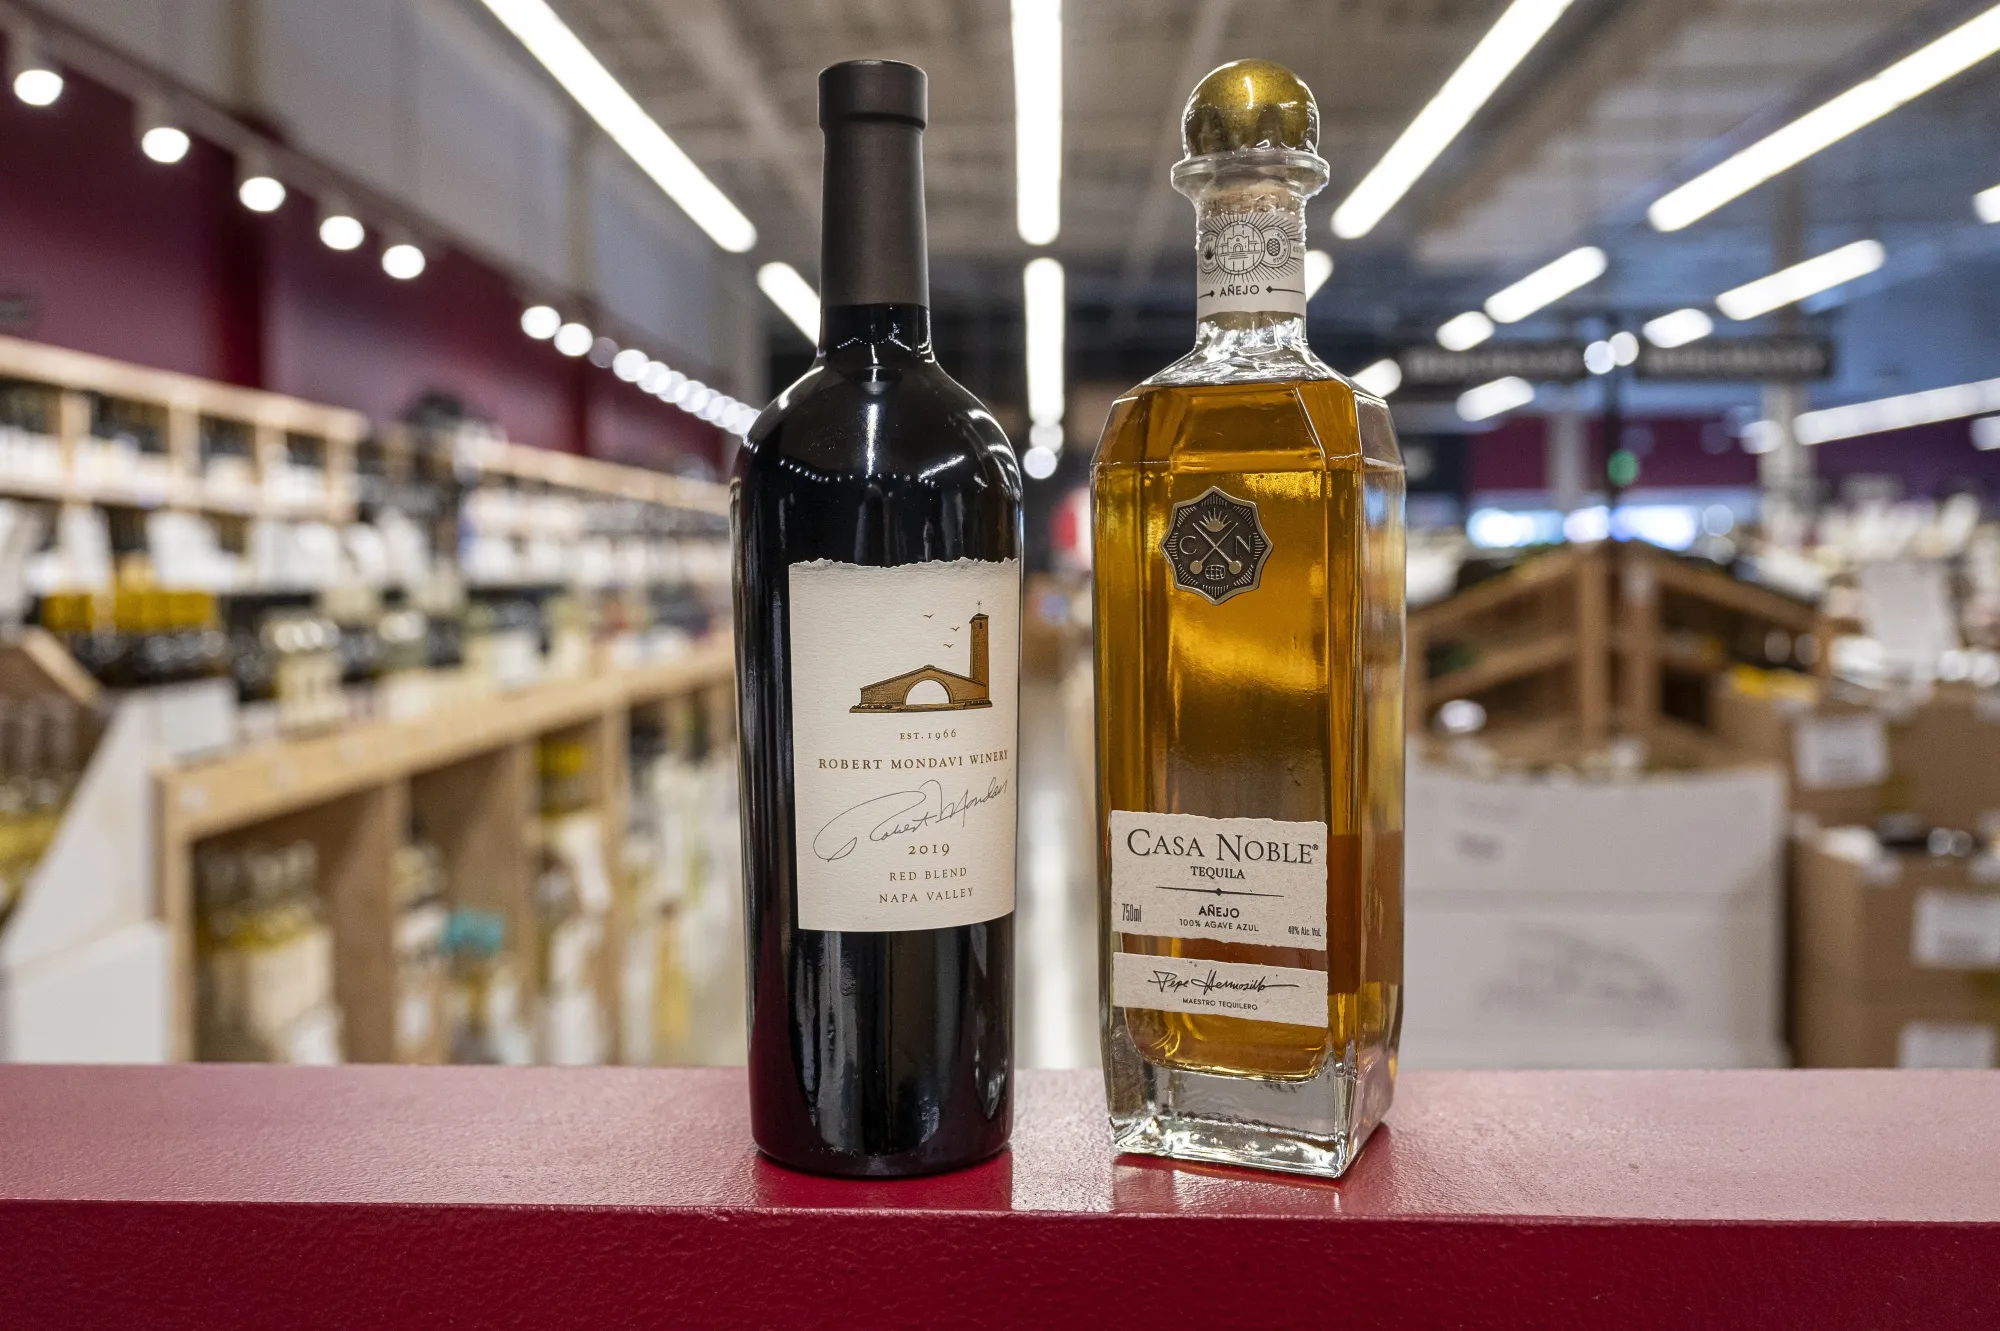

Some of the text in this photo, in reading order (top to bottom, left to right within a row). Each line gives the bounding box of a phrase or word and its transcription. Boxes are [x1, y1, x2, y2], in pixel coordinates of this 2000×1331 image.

[1220, 284, 1260, 297] AÑEJO
[1179, 535, 1252, 555] C N
[818, 749, 1008, 769] ROBERT MONDAVI WINERY
[908, 843, 951, 856] 2019
[889, 867, 968, 882] RED BLEND
[1190, 865, 1246, 880] TEQUILA
[879, 887, 974, 904] NAPA VALLEY
[1122, 903, 1142, 923] 750ml
[1198, 903, 1240, 919] AÑEJO
[1179, 918, 1260, 932] 100% AGAVE AZUL
[1182, 997, 1258, 1011] MAESTRO TEQUILERO
